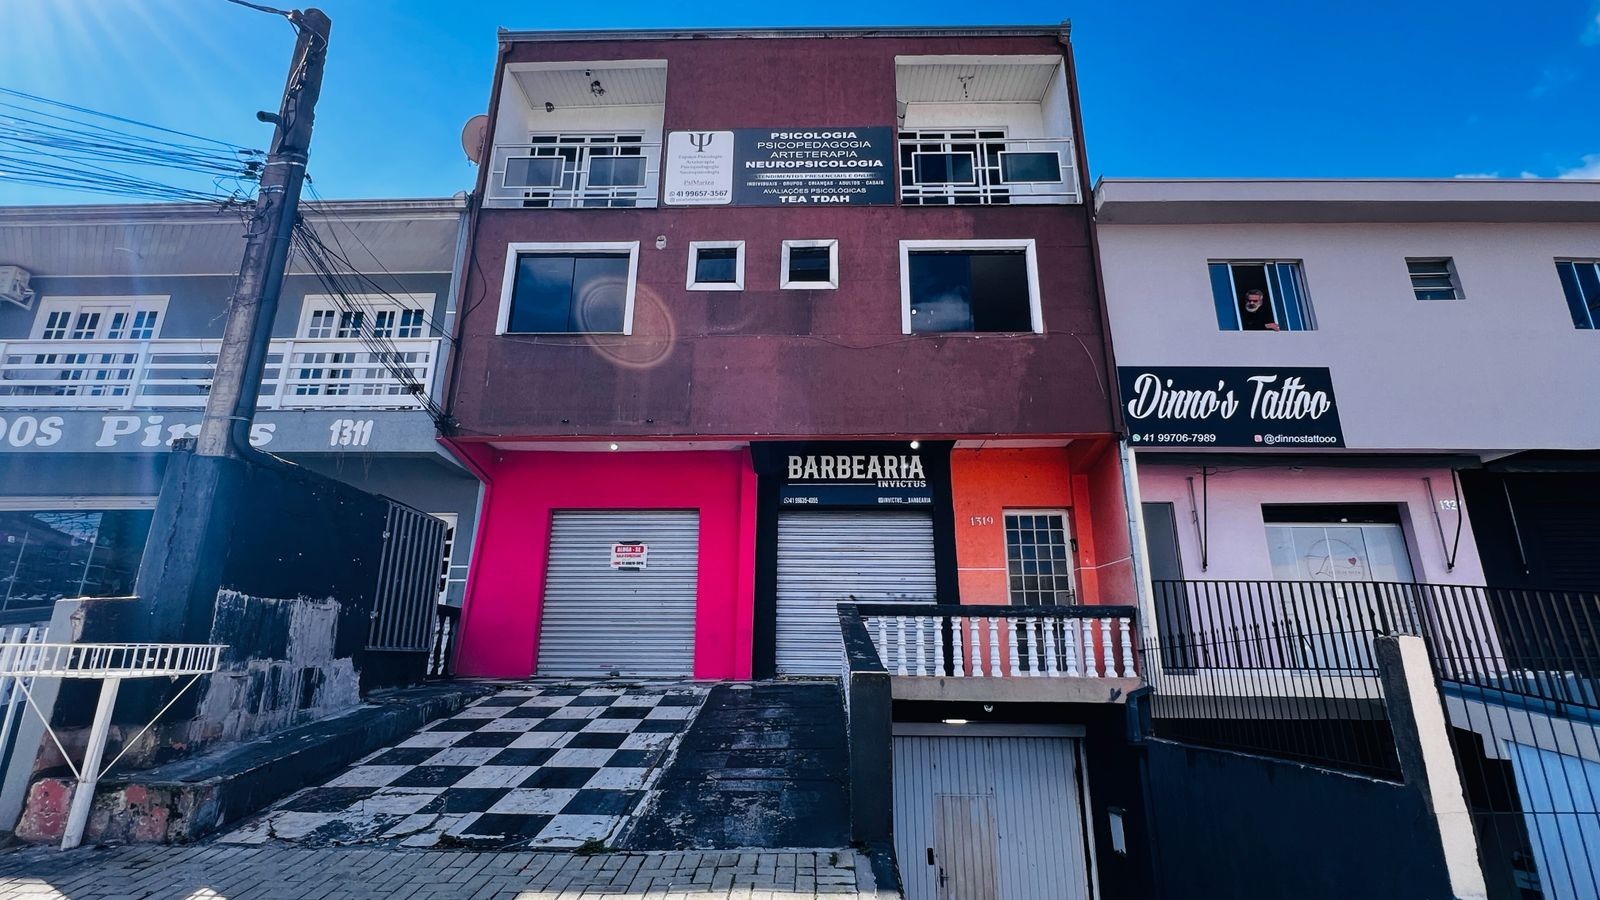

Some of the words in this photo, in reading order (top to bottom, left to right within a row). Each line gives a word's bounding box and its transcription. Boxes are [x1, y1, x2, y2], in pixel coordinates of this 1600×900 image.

[770, 131, 857, 140] PSICOLOGIA
[757, 141, 872, 149] PSICOPEDAGOGIA
[770, 151, 858, 159] ARTETERAPIA
[745, 160, 884, 168] NEUROPSICOLOGIA
[763, 187, 809, 195] AVALIAÇÕES
[779, 195, 807, 203] TEA
[811, 195, 850, 203] TDAH
[1127, 373, 1240, 420] Dinno's
[1246, 374, 1331, 420] Tattoo
[329, 418, 374, 447] 1311
[1143, 433, 1154, 442] 41
[1157, 433, 1217, 443] 99706-7989
[1264, 433, 1337, 444] @dinnostattooo
[787, 455, 926, 479] BARBEARIA
[877, 480, 927, 488] INVICTUS
[970, 516, 994, 526] 1319
